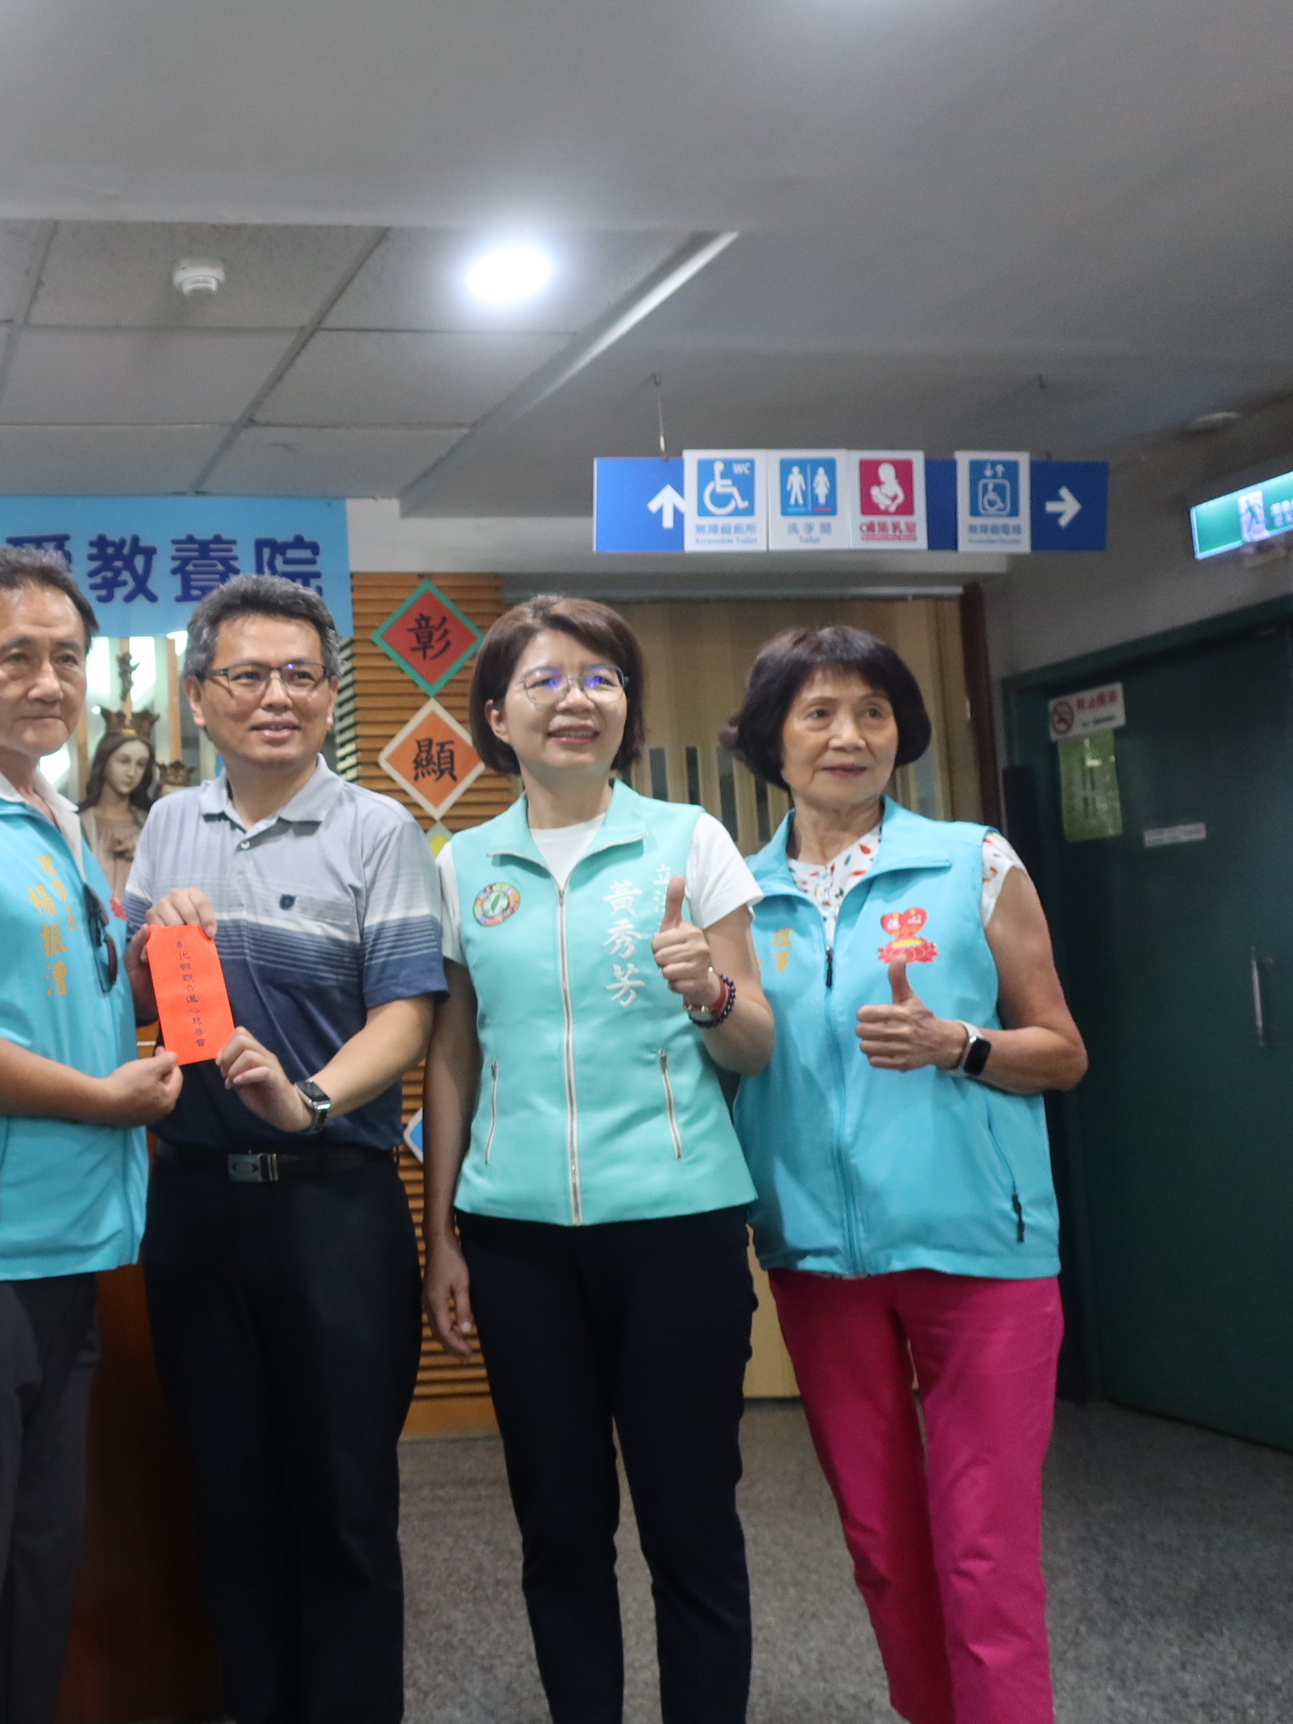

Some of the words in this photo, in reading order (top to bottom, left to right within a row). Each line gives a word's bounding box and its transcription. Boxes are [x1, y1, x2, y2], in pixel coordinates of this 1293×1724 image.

[732, 462, 751, 475] WC
[603, 880, 645, 1008] 黃秀芳
